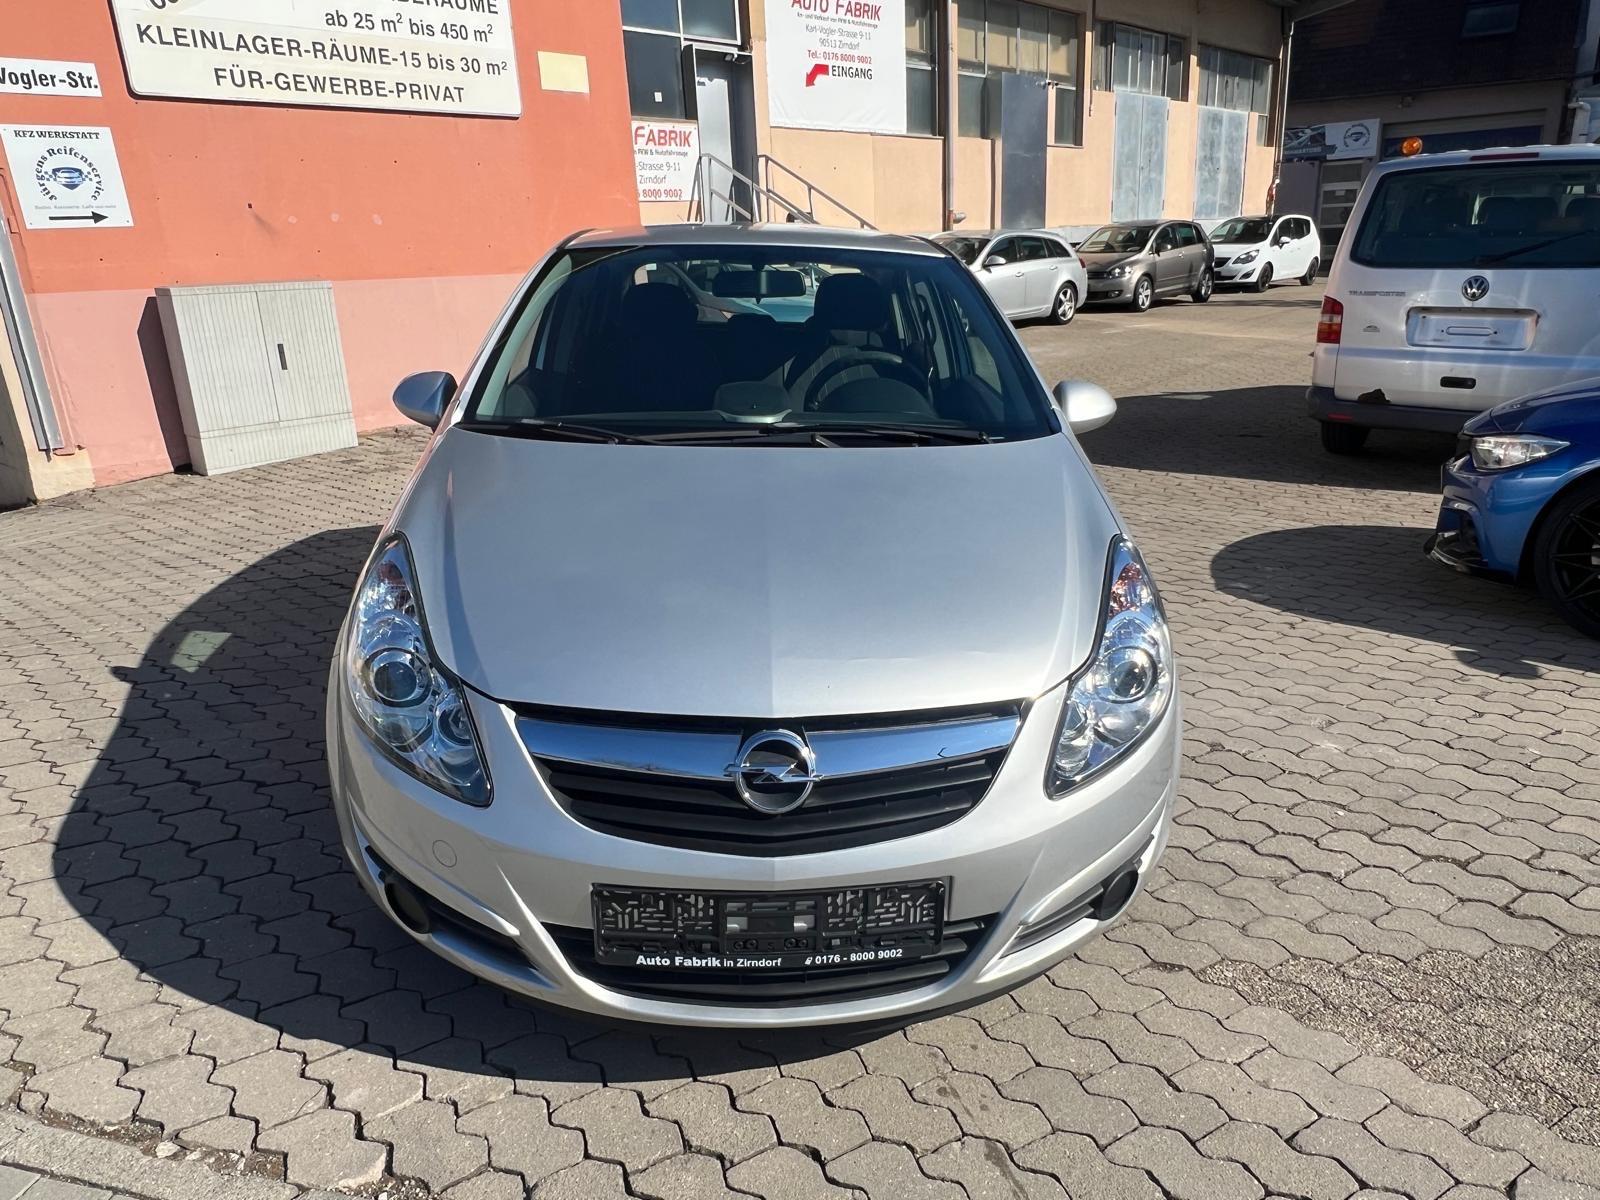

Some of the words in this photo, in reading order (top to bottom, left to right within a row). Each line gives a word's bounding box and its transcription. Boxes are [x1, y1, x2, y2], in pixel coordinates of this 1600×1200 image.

[835, 0, 882, 22] FABRIK
[325, 10, 348, 28] ab
[353, 13, 375, 31] 25
[409, 18, 435, 37] bis
[440, 22, 469, 41] 450
[838, 40, 860, 50] Zirndorf
[427, 52, 456, 72] bis
[460, 57, 481, 74] 30
[822, 51, 839, 61] 0176
[840, 53, 856, 63] 8000
[856, 55, 872, 64] 9002
[831, 65, 873, 80] EINGANG
[213, 63, 465, 103] FÜR-GEWERBE-PRIVAT
[13, 129, 36, 138] KFZ
[36, 131, 100, 140] WERKSTATT
[634, 125, 692, 148] FABRIK
[665, 161, 681, 172] 9-11
[638, 174, 667, 185] Zirndorf
[642, 188, 662, 199] 8000
[663, 188, 683, 200] 9002
[636, 955, 671, 966] Auto
[674, 956, 721, 967] Fabrik
[723, 958, 734, 967] in
[736, 957, 782, 967] Zirndorf
[815, 954, 841, 964] 0176
[850, 951, 875, 962] 8000
[877, 948, 903, 959] 9002
